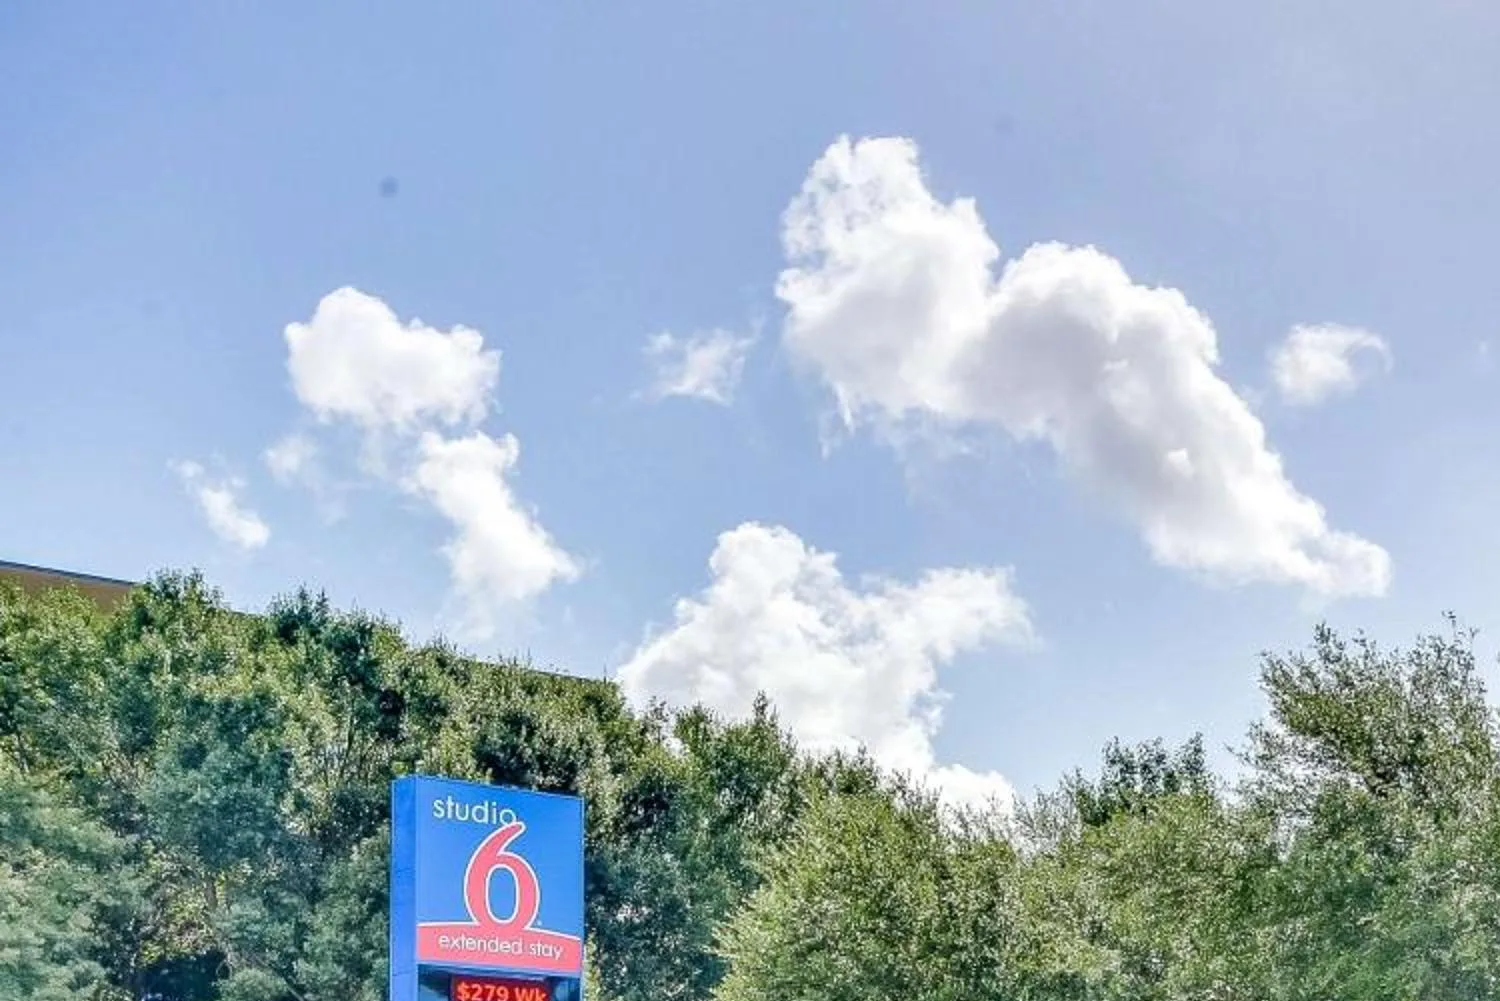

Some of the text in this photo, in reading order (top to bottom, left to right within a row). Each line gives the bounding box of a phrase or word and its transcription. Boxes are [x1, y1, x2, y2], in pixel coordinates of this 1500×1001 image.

[433, 796, 517, 826] studio
[463, 821, 541, 929] 6
[437, 933, 564, 961] extended stay
